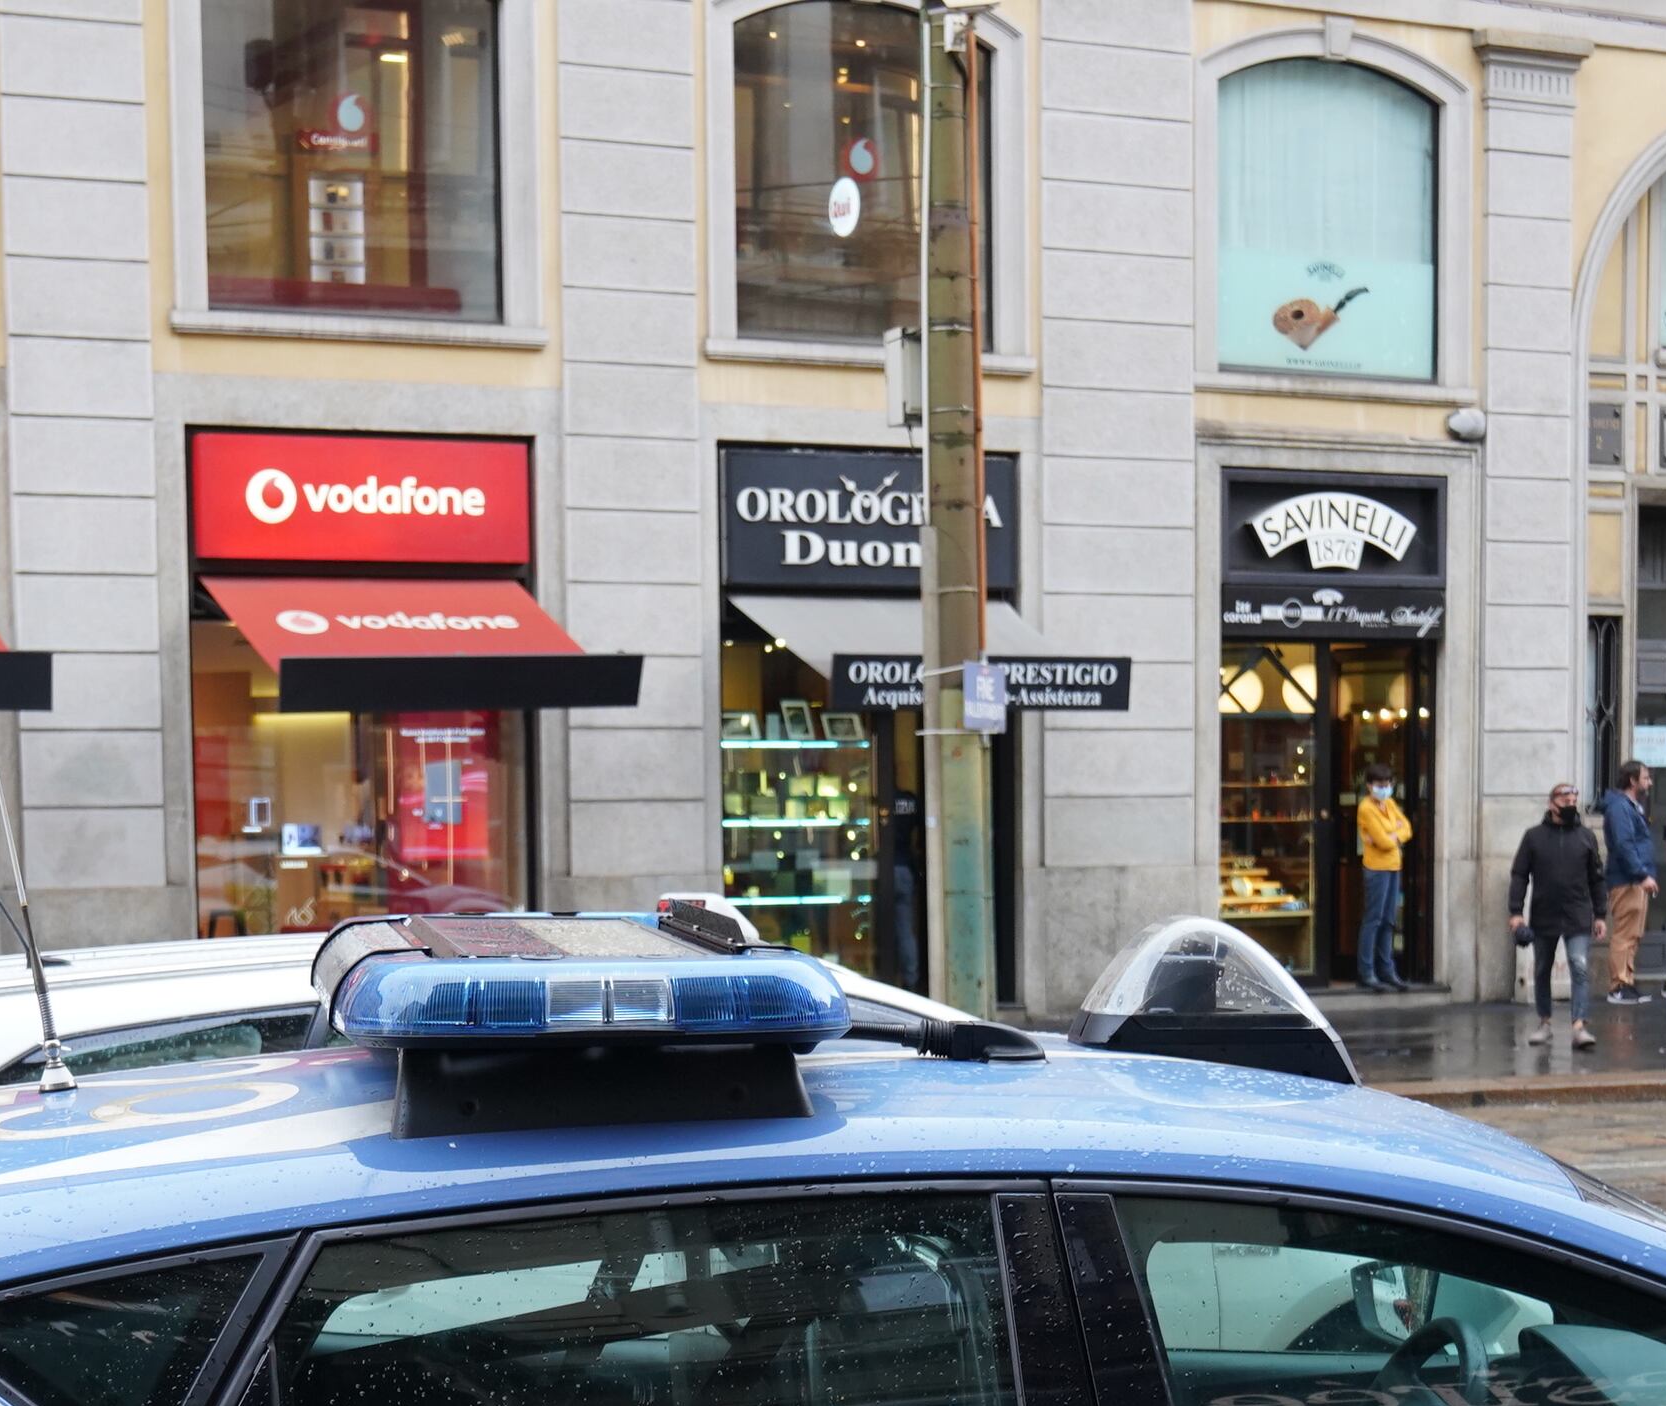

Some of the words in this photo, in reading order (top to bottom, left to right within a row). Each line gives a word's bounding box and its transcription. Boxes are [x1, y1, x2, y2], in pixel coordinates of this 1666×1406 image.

[301, 475, 486, 516] vodafone
[1262, 498, 1408, 552] SAVINELLI
[1314, 537, 1357, 564] 1876
[334, 611, 520, 631] vodafone
